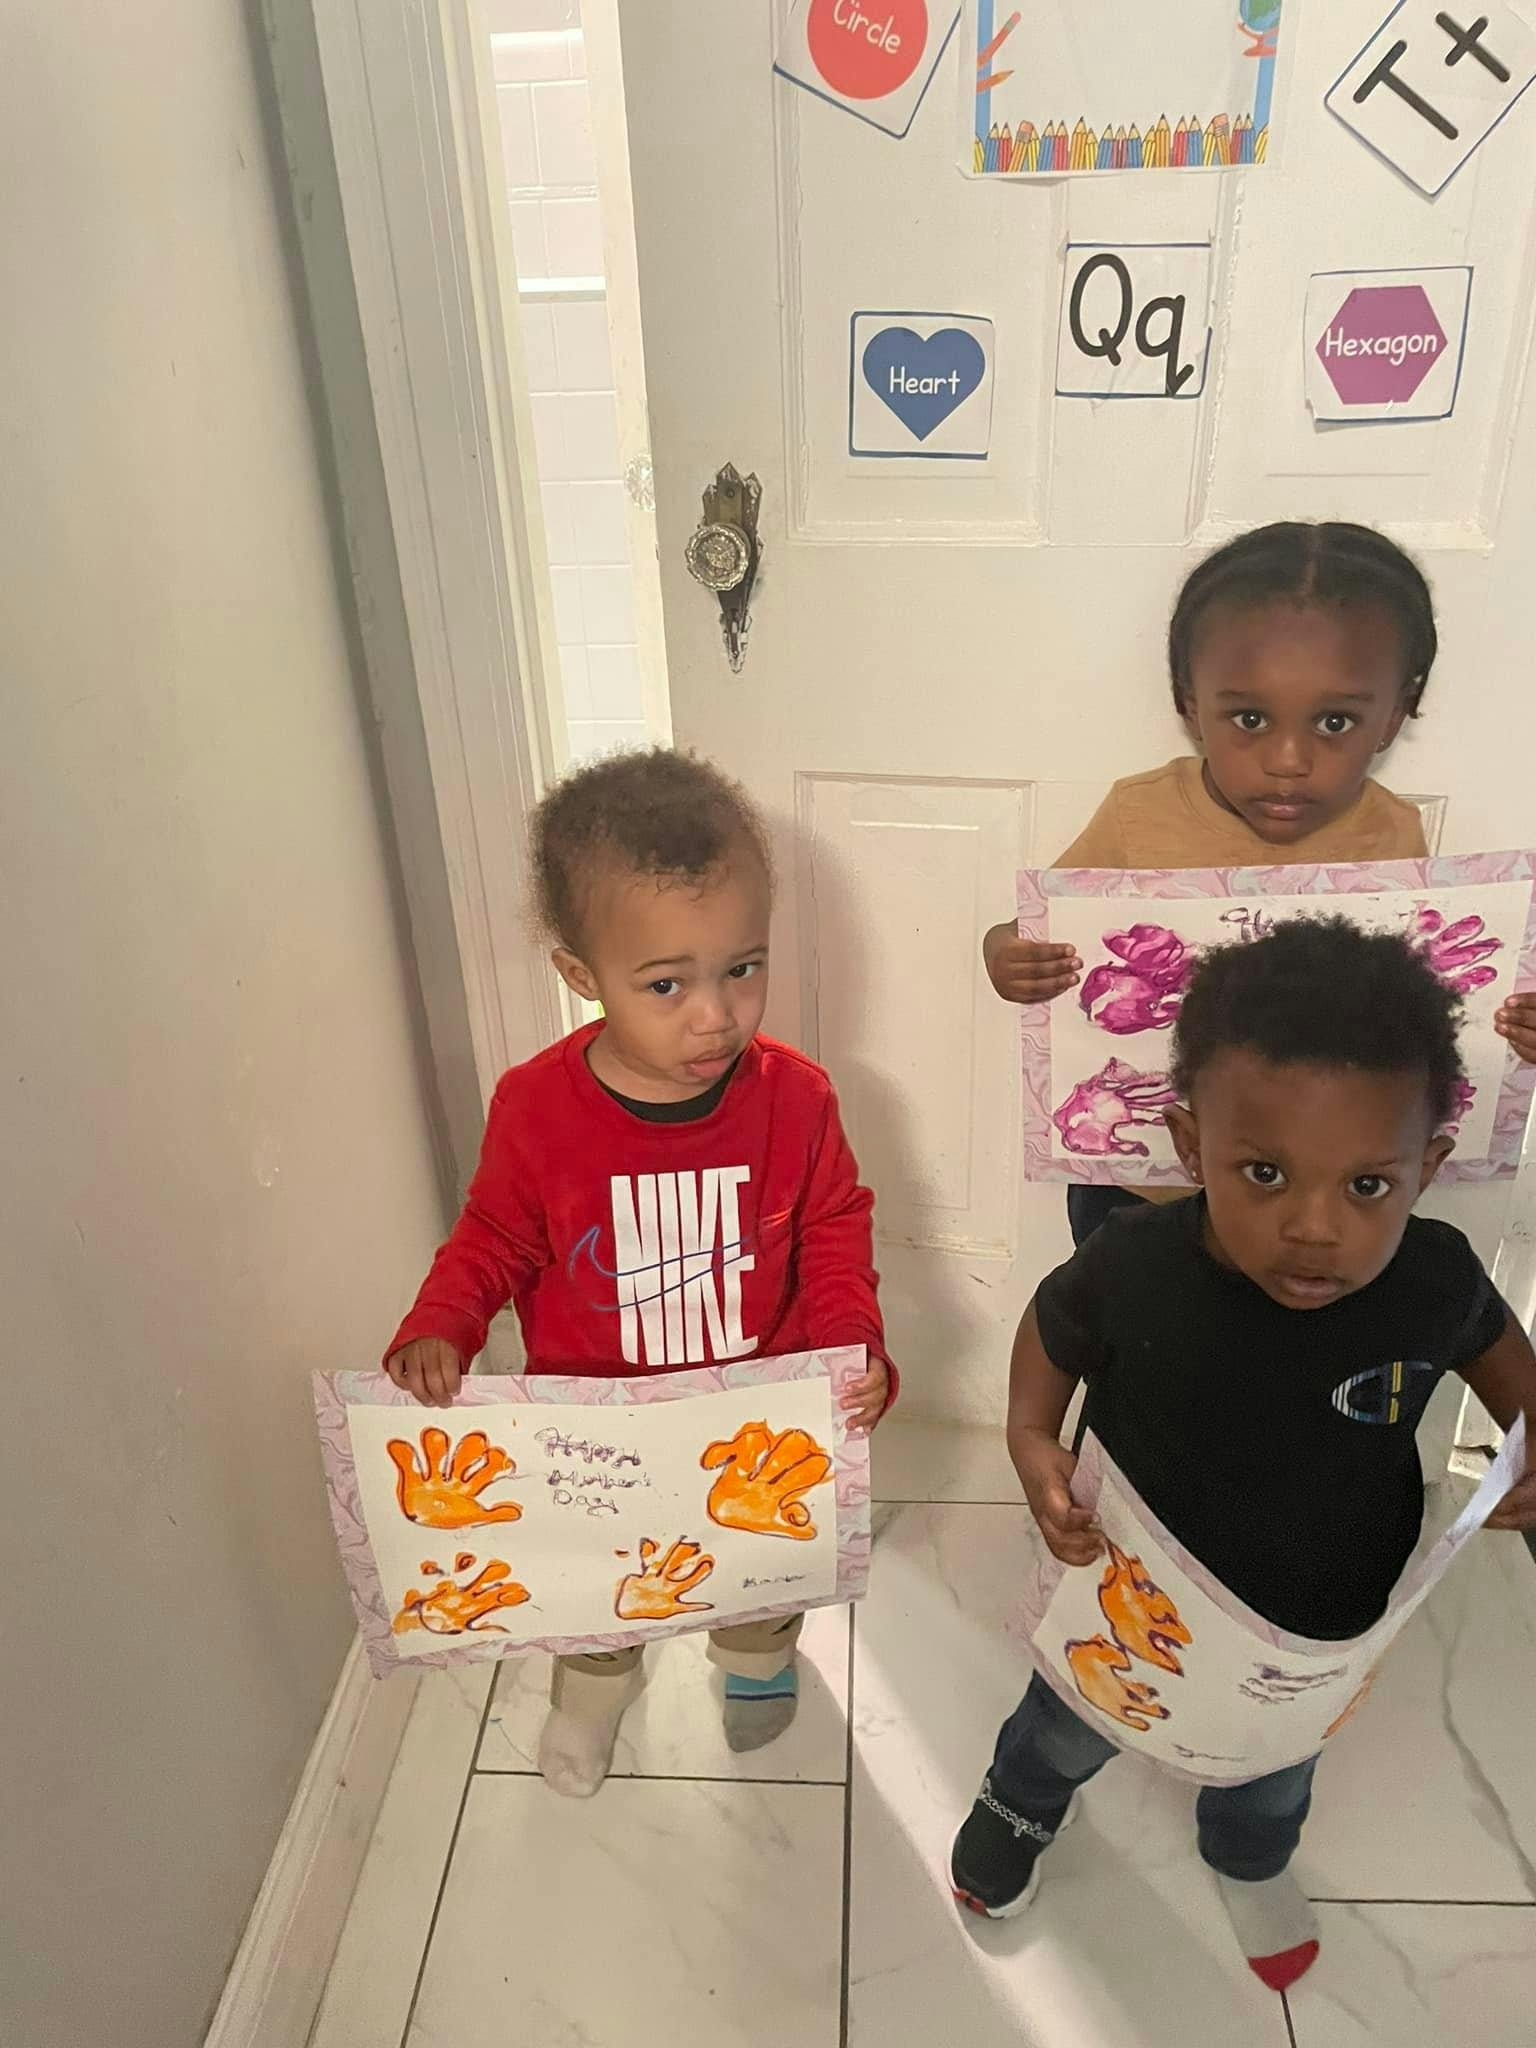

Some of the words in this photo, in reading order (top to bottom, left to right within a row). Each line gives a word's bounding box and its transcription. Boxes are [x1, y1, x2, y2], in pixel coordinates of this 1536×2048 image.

[832, 0, 901, 54] Circle
[1069, 253, 1195, 397] Qq
[1324, 326, 1438, 366] Hexagon
[889, 365, 961, 395] Heart
[610, 1164, 759, 1366] NIKE
